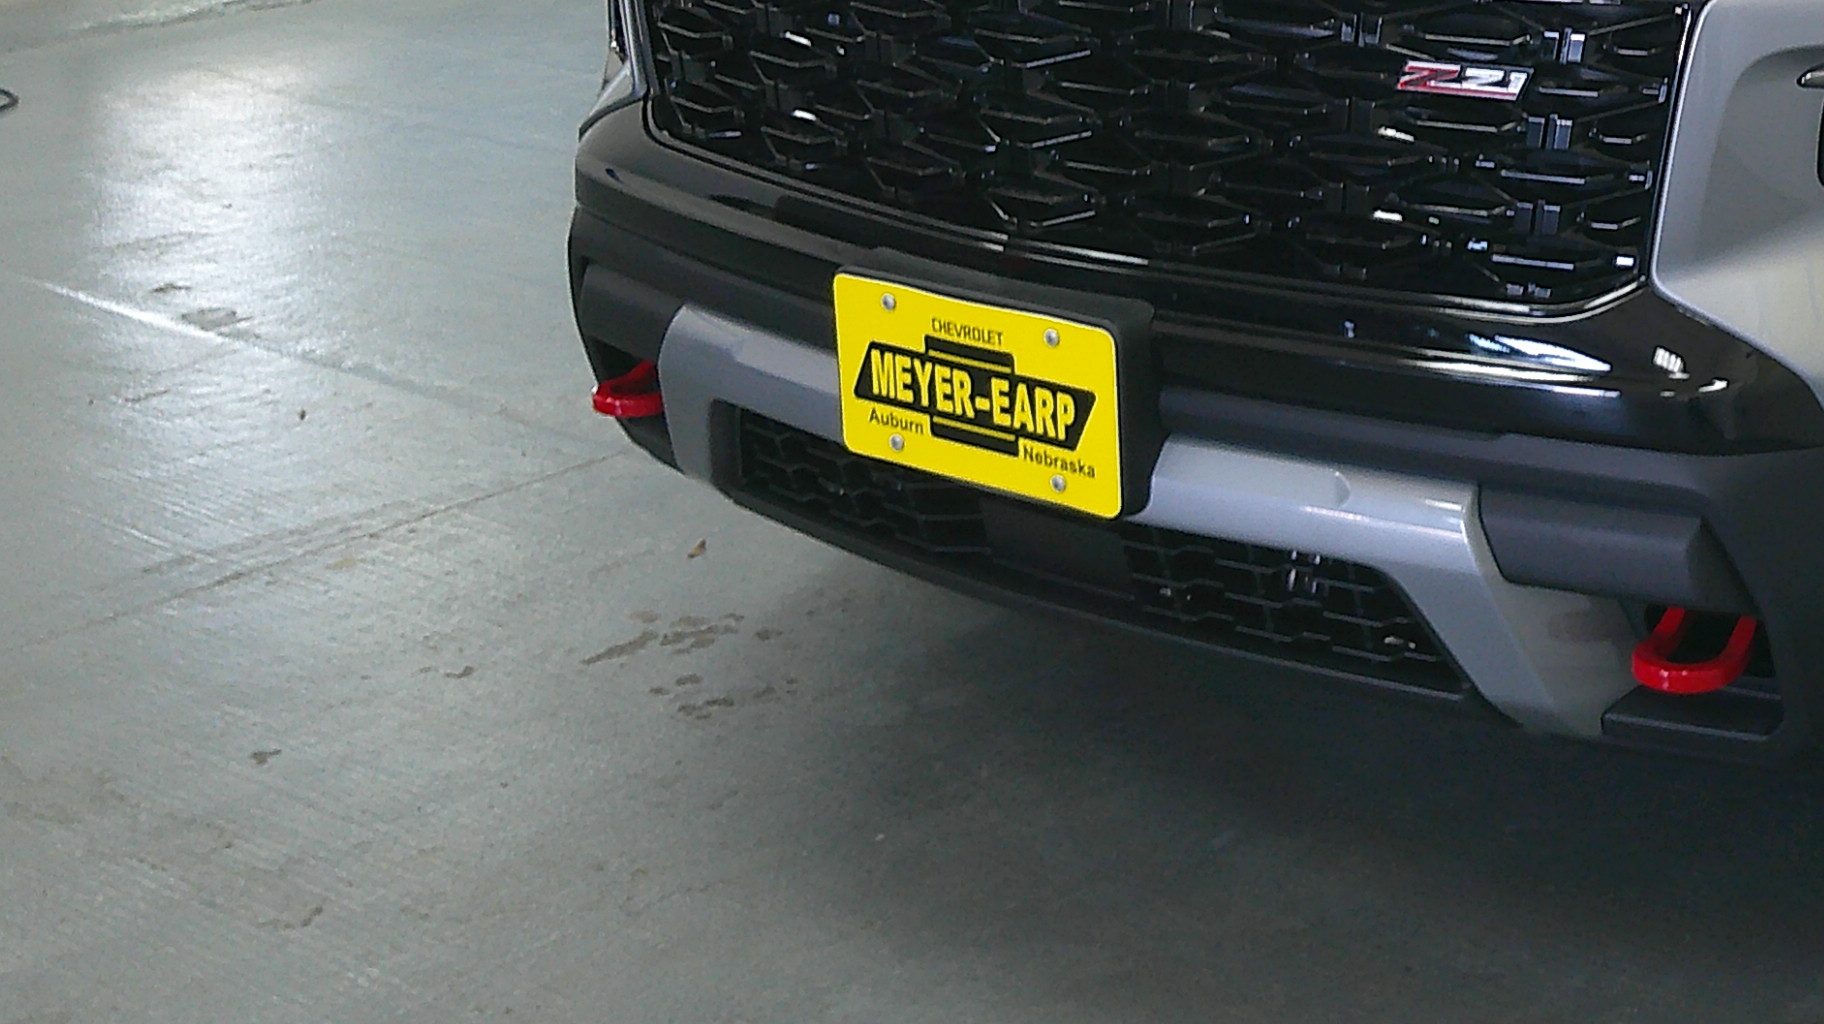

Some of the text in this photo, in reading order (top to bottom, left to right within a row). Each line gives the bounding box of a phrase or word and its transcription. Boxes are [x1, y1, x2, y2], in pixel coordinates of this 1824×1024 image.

[931, 318, 1004, 346] CHEVROLET
[870, 348, 1076, 441] MEYER-EARP
[869, 408, 923, 436] Auburn
[1023, 446, 1096, 479] Nebraska
